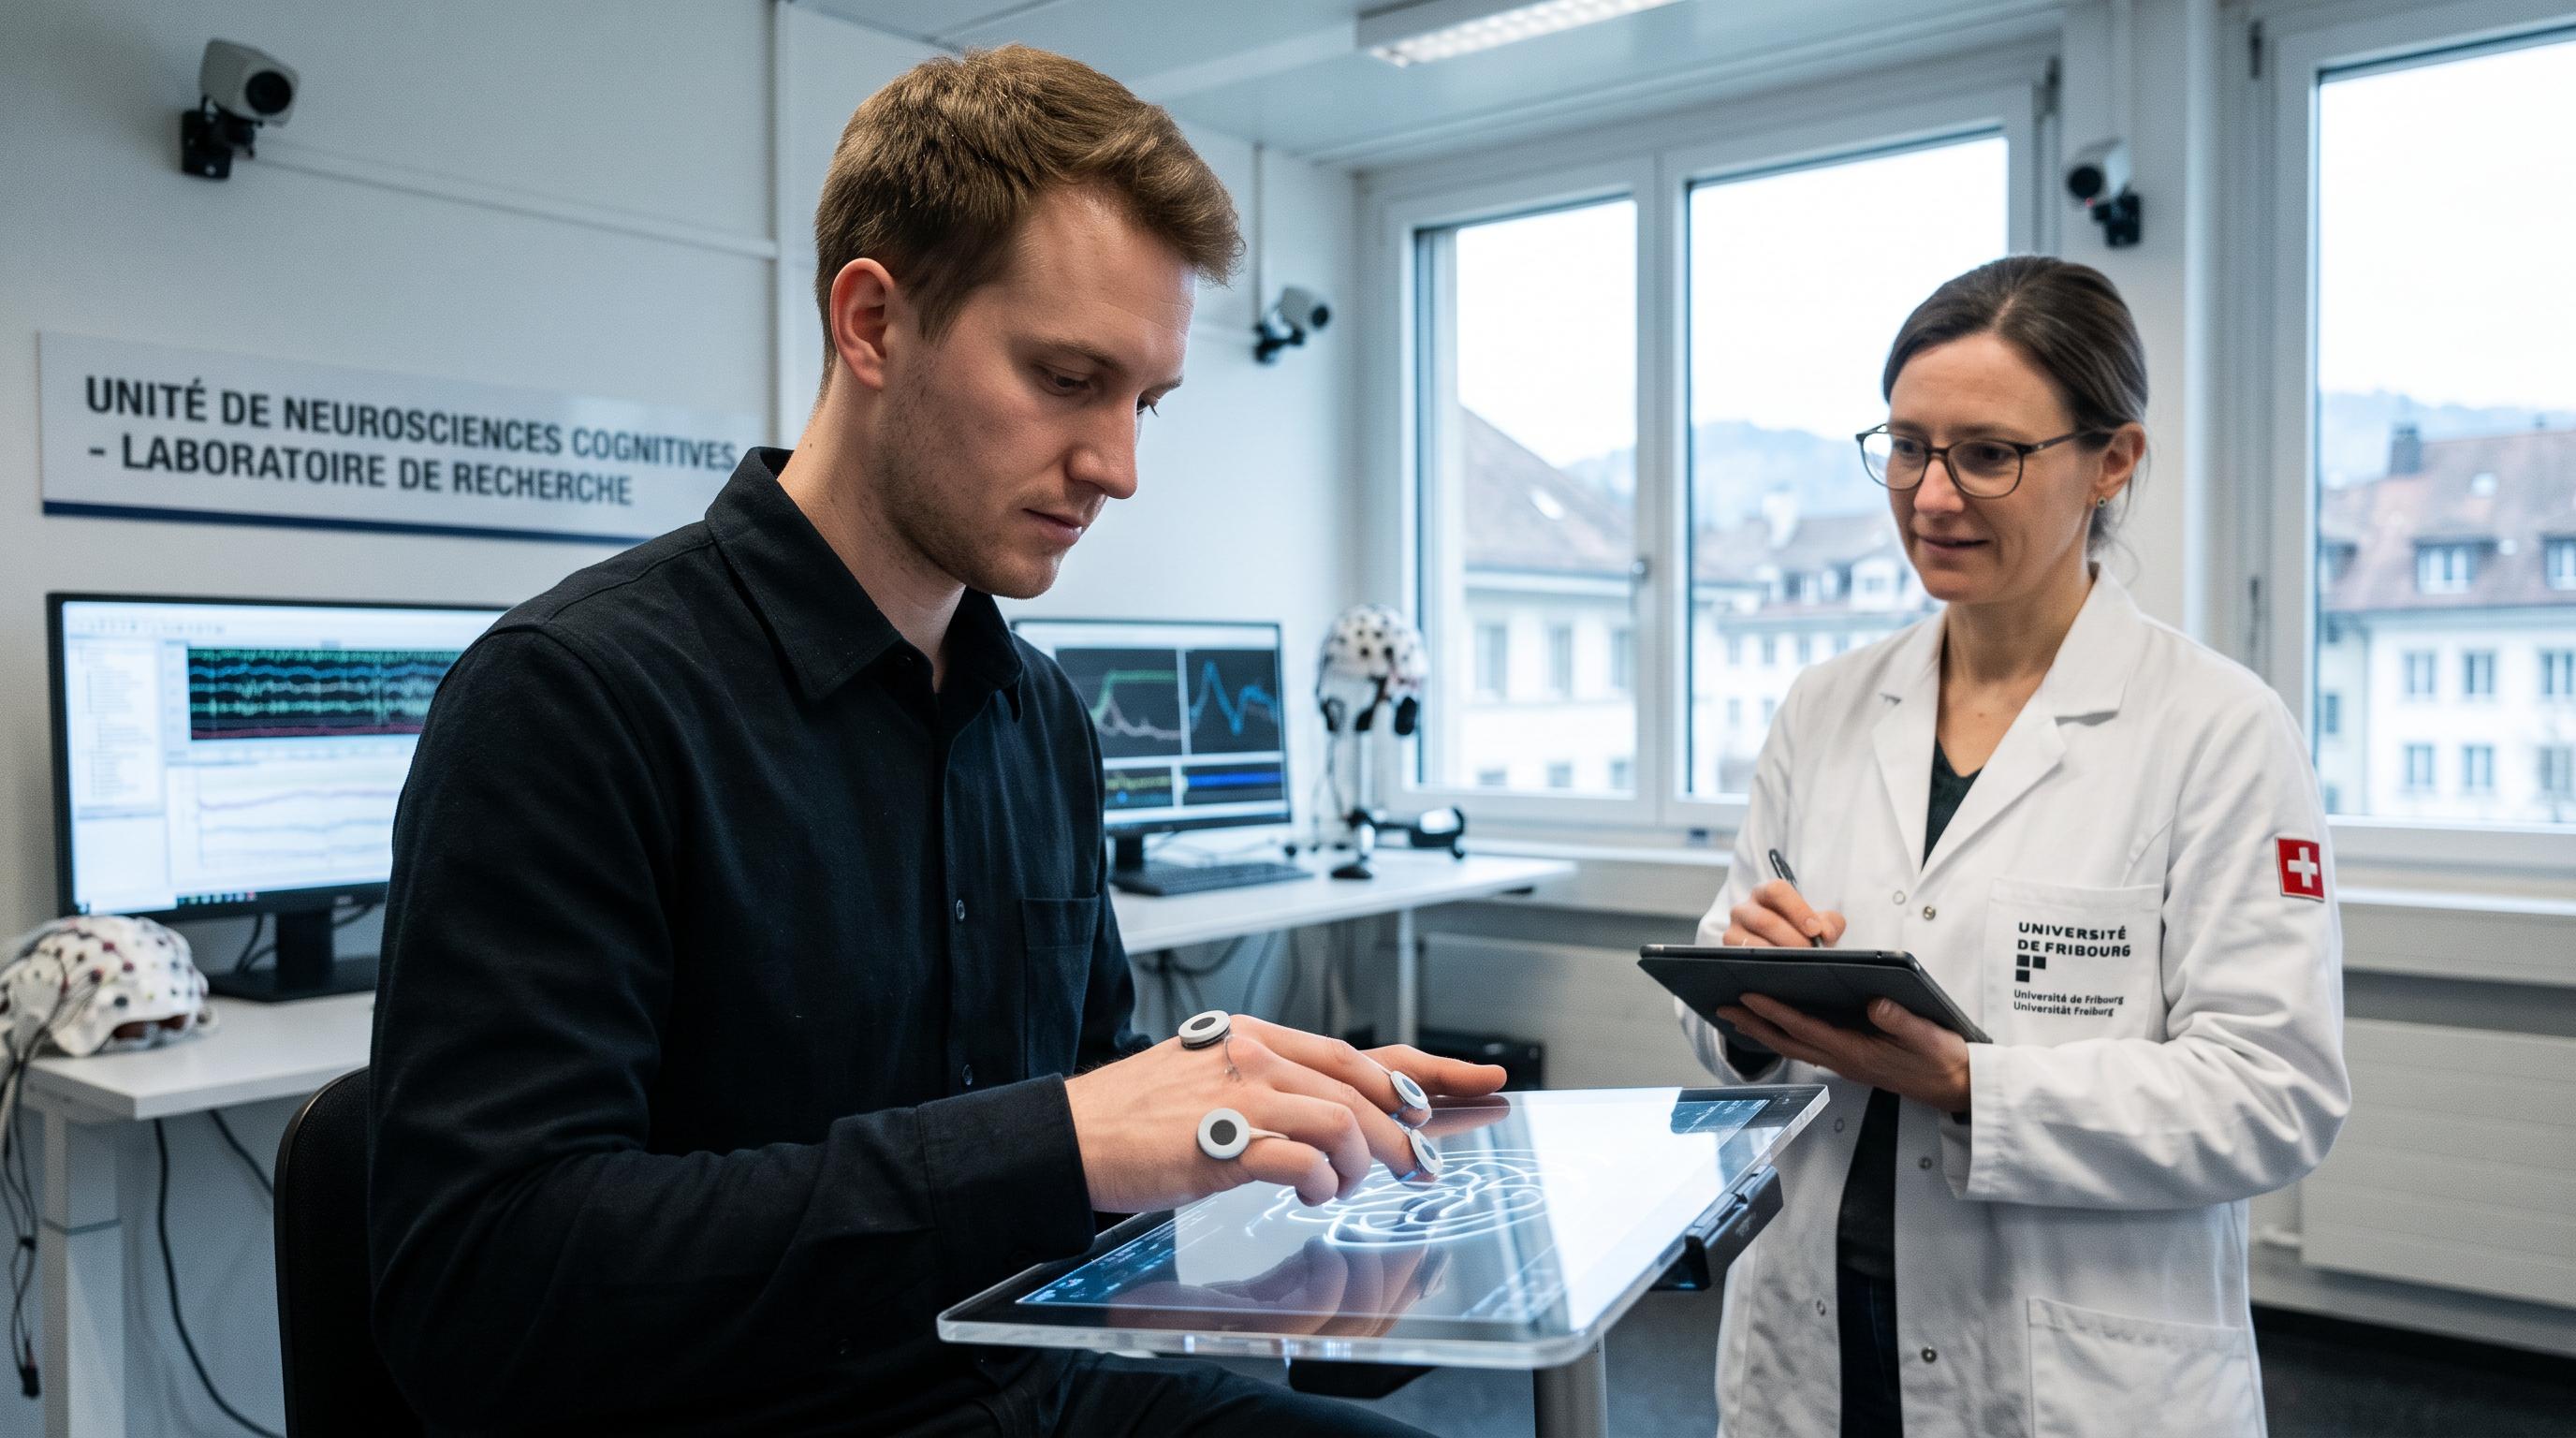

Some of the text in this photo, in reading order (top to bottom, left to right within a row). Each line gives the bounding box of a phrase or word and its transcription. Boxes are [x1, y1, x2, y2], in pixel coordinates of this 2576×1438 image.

[86, 374, 739, 473] UNITÉ DE NEUROSCIENCES COGNITIVES
[122, 432, 388, 489] LABORATOIRE
[399, 456, 443, 493] DE
[452, 461, 634, 506] RECHERCHE
[2019, 922, 2126, 940] UNIVERSITÉ
[2018, 939, 2130, 957] DE FRIBOURG
[2070, 993, 2083, 1005] de
[2085, 995, 2125, 1006] Fribourg
[2014, 1002, 2115, 1018] Universität Freiburg
